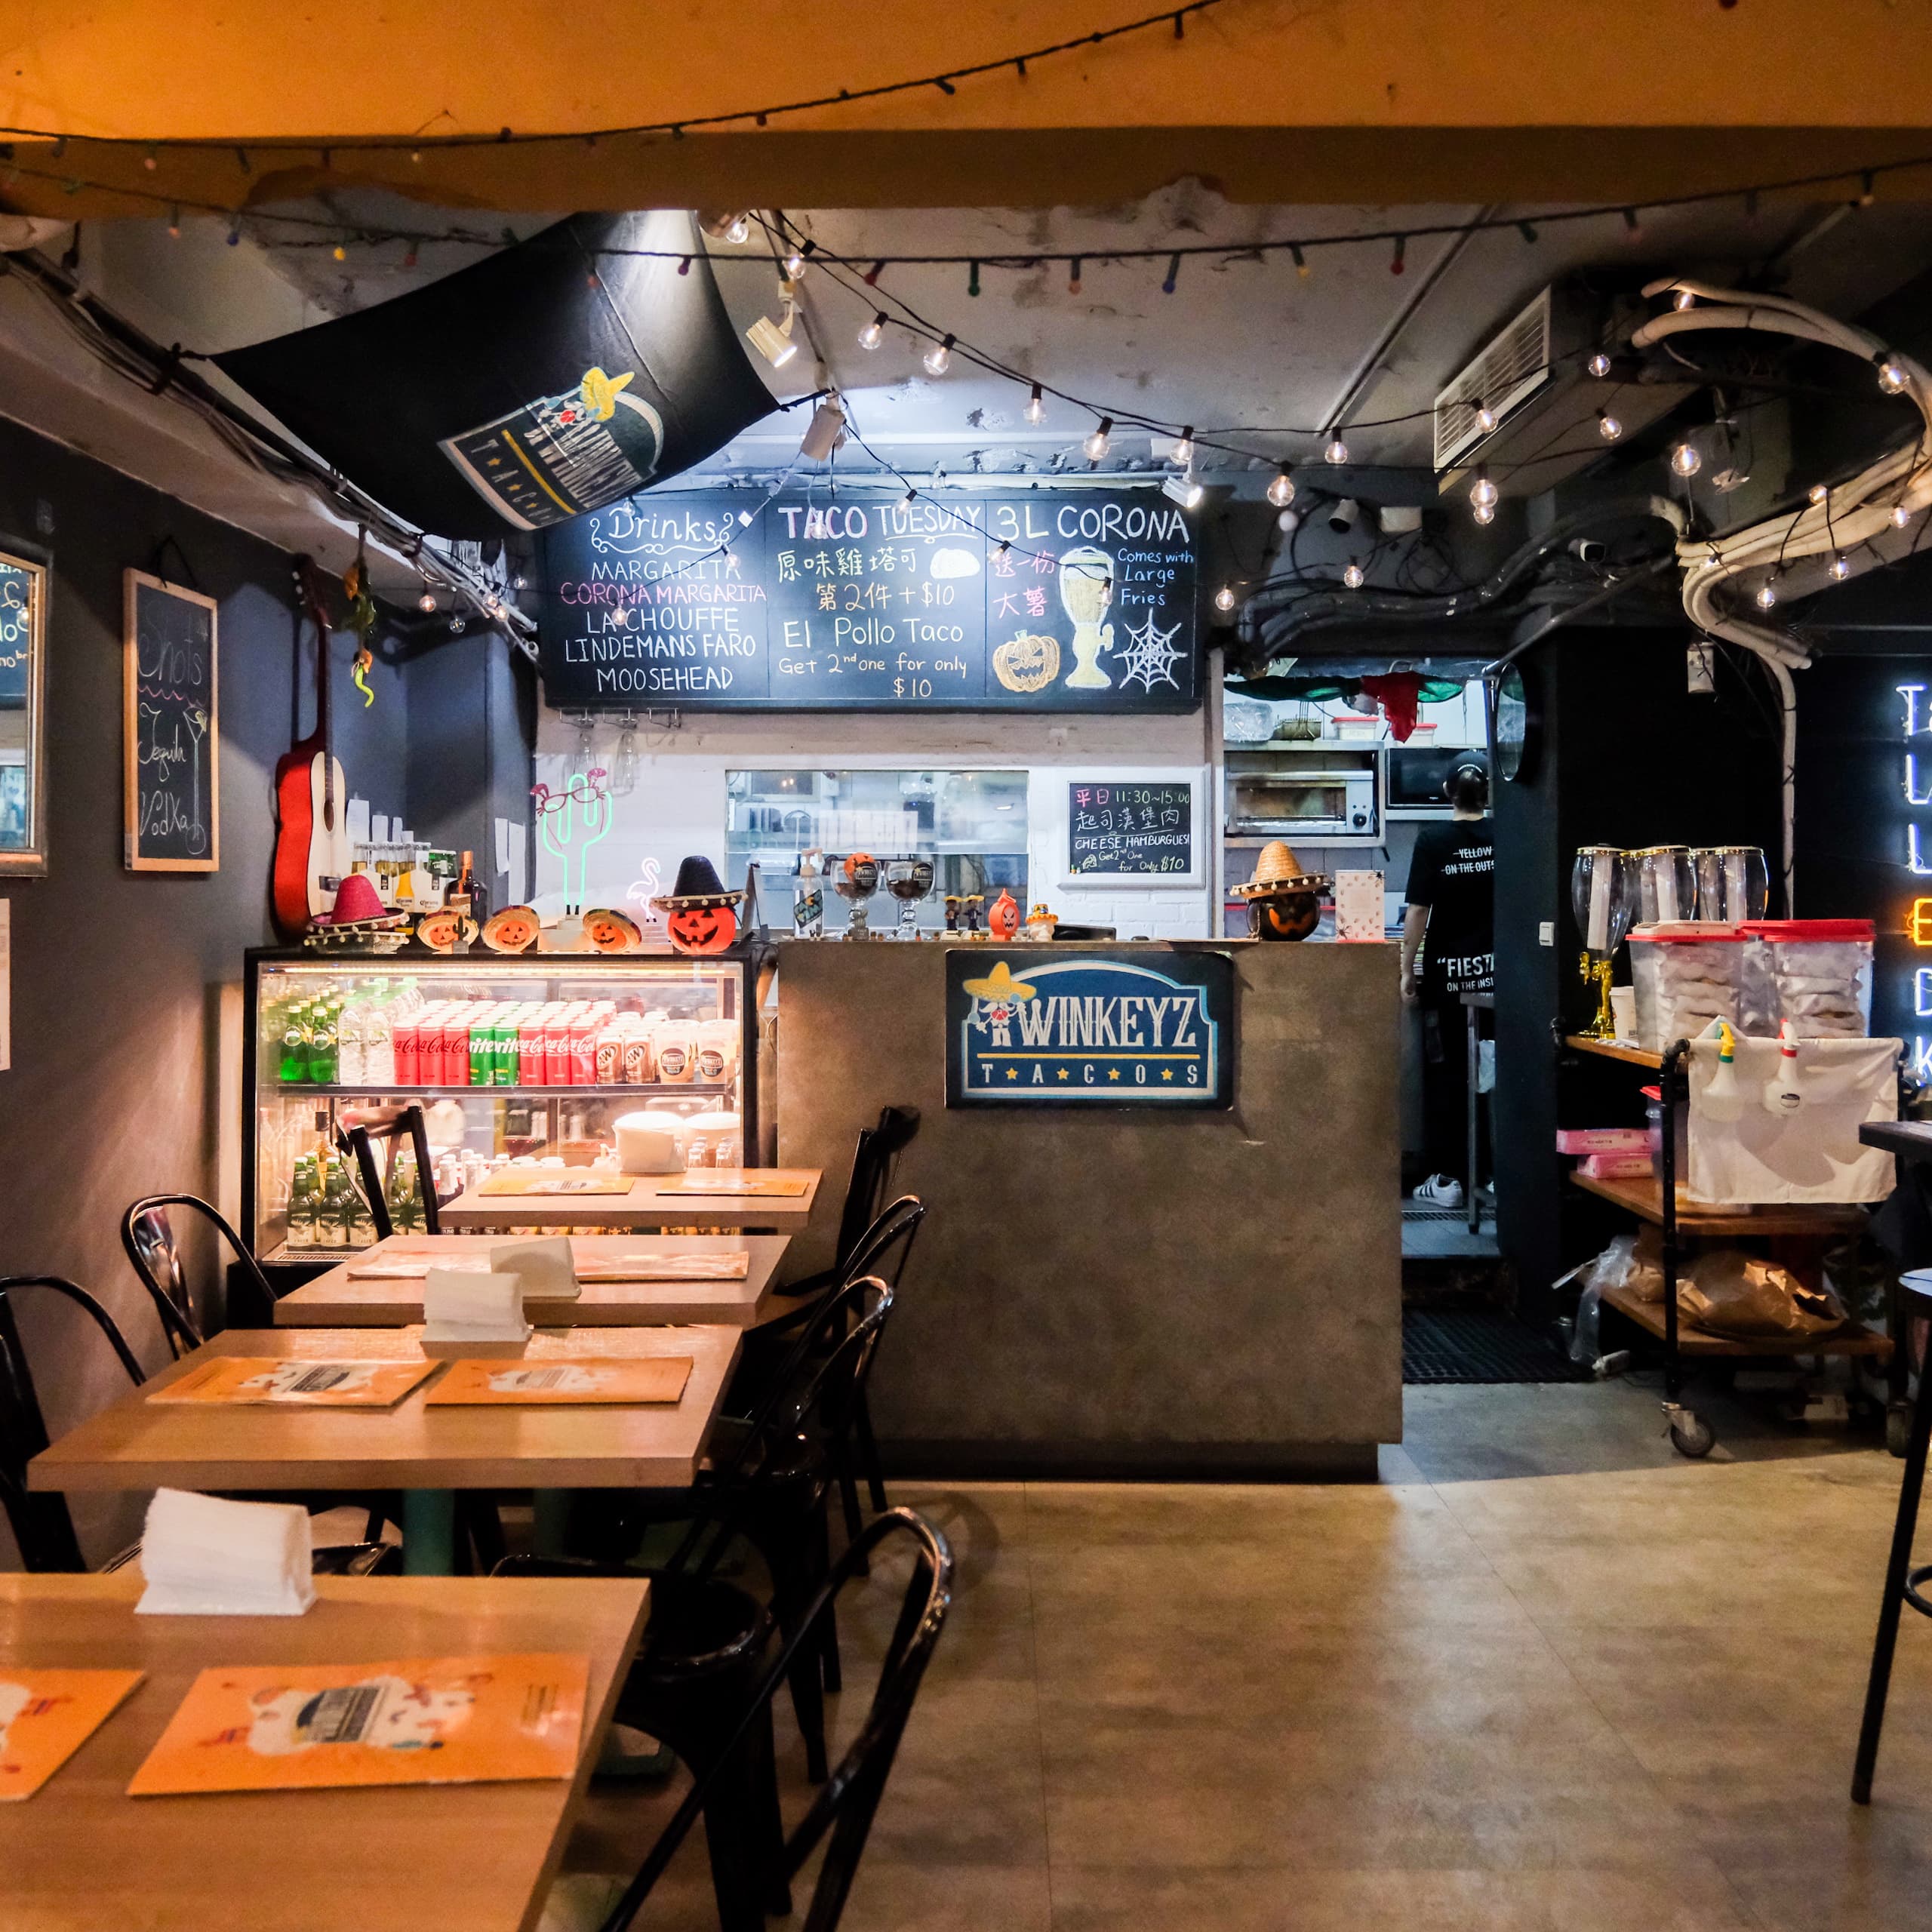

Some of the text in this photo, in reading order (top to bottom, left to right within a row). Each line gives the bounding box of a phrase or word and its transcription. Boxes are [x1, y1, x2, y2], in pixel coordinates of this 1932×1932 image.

[609, 507, 715, 542] Drinks
[777, 505, 981, 539] TACO TUESDAY
[997, 503, 1189, 543] 3L CORONA
[1118, 548, 1195, 563] Comes with
[592, 560, 740, 580] MARGARITA
[1124, 565, 1175, 588] Large
[561, 583, 767, 605] CORONA MARGARITA
[992, 585, 1048, 619] 大薯
[1121, 588, 1165, 606] Fries
[587, 607, 739, 633] LA CHOUFFE
[783, 617, 964, 648] El Pollo Taco
[566, 633, 756, 662] LINDEMANS FARO
[779, 658, 818, 675] Get
[858, 658, 886, 671] one
[896, 652, 925, 672] for
[934, 655, 967, 678] only
[597, 666, 734, 692] MOOSEHEAD
[894, 676, 932, 697] $10
[1076, 789, 1109, 808] 平日
[1075, 837, 1121, 850] CHEESE
[1459, 846, 1492, 858] YELLOW
[1161, 856, 1184, 872] $10
[1445, 864, 1457, 875] ON
[1458, 863, 1474, 873] THE
[1447, 982, 1459, 992] ON
[1460, 980, 1476, 991] THE
[1018, 996, 1197, 1048] WINKEYZ
